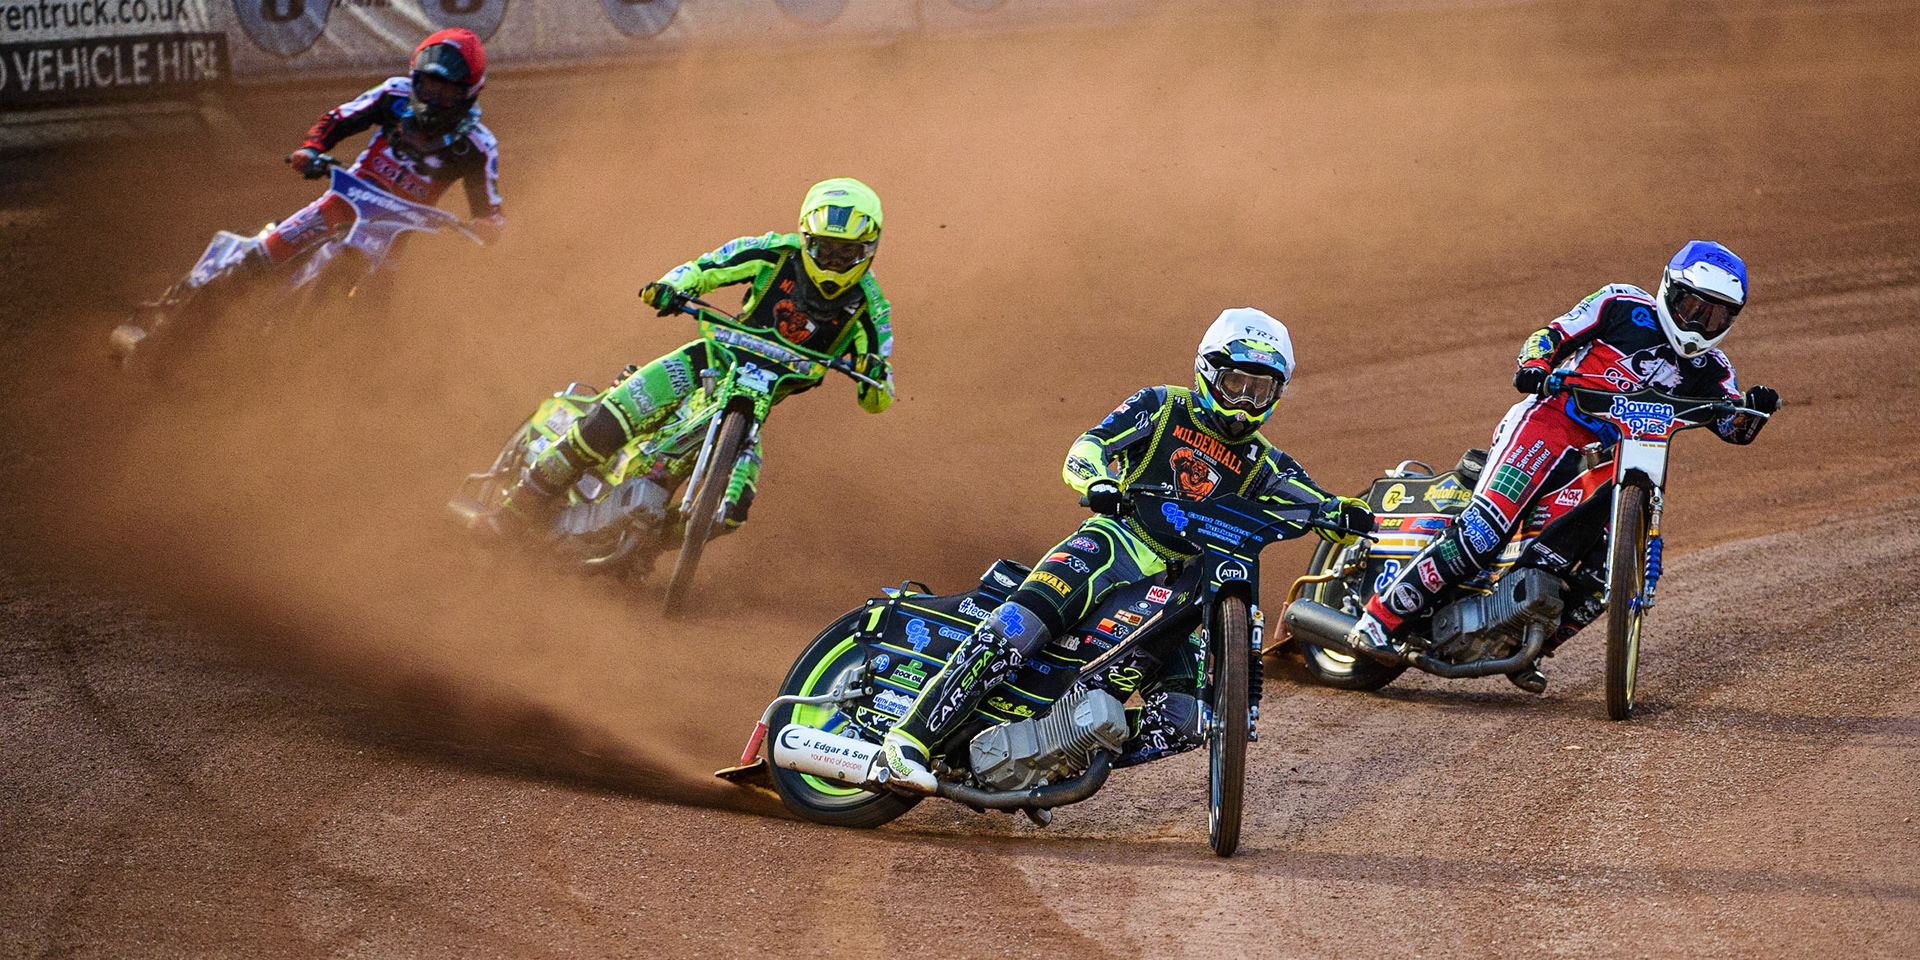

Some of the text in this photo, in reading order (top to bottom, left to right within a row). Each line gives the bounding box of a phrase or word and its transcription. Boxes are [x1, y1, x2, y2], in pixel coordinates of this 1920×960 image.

[13, 43, 151, 93] VEHICLE
[156, 40, 217, 83] HIRE
[1610, 395, 1674, 418] Bowen
[1630, 418, 1667, 435] Pies
[1172, 425, 1242, 475] MILDENHALL
[1246, 444, 1258, 462] 1
[1516, 439, 1546, 469] Services
[1526, 448, 1552, 476] Limited
[1560, 489, 1583, 501] NGK
[1380, 518, 1404, 527] SCT
[1463, 507, 1499, 545] Bowen
[1220, 568, 1242, 578] ATPI
[1149, 587, 1170, 600] NGK
[865, 605, 886, 631] 1
[893, 668, 924, 684] ROCK OIL
[876, 703, 896, 713] ROOFING
[813, 742, 841, 756] Edgar
[842, 748, 850, 756] &
[851, 749, 869, 761] Son
